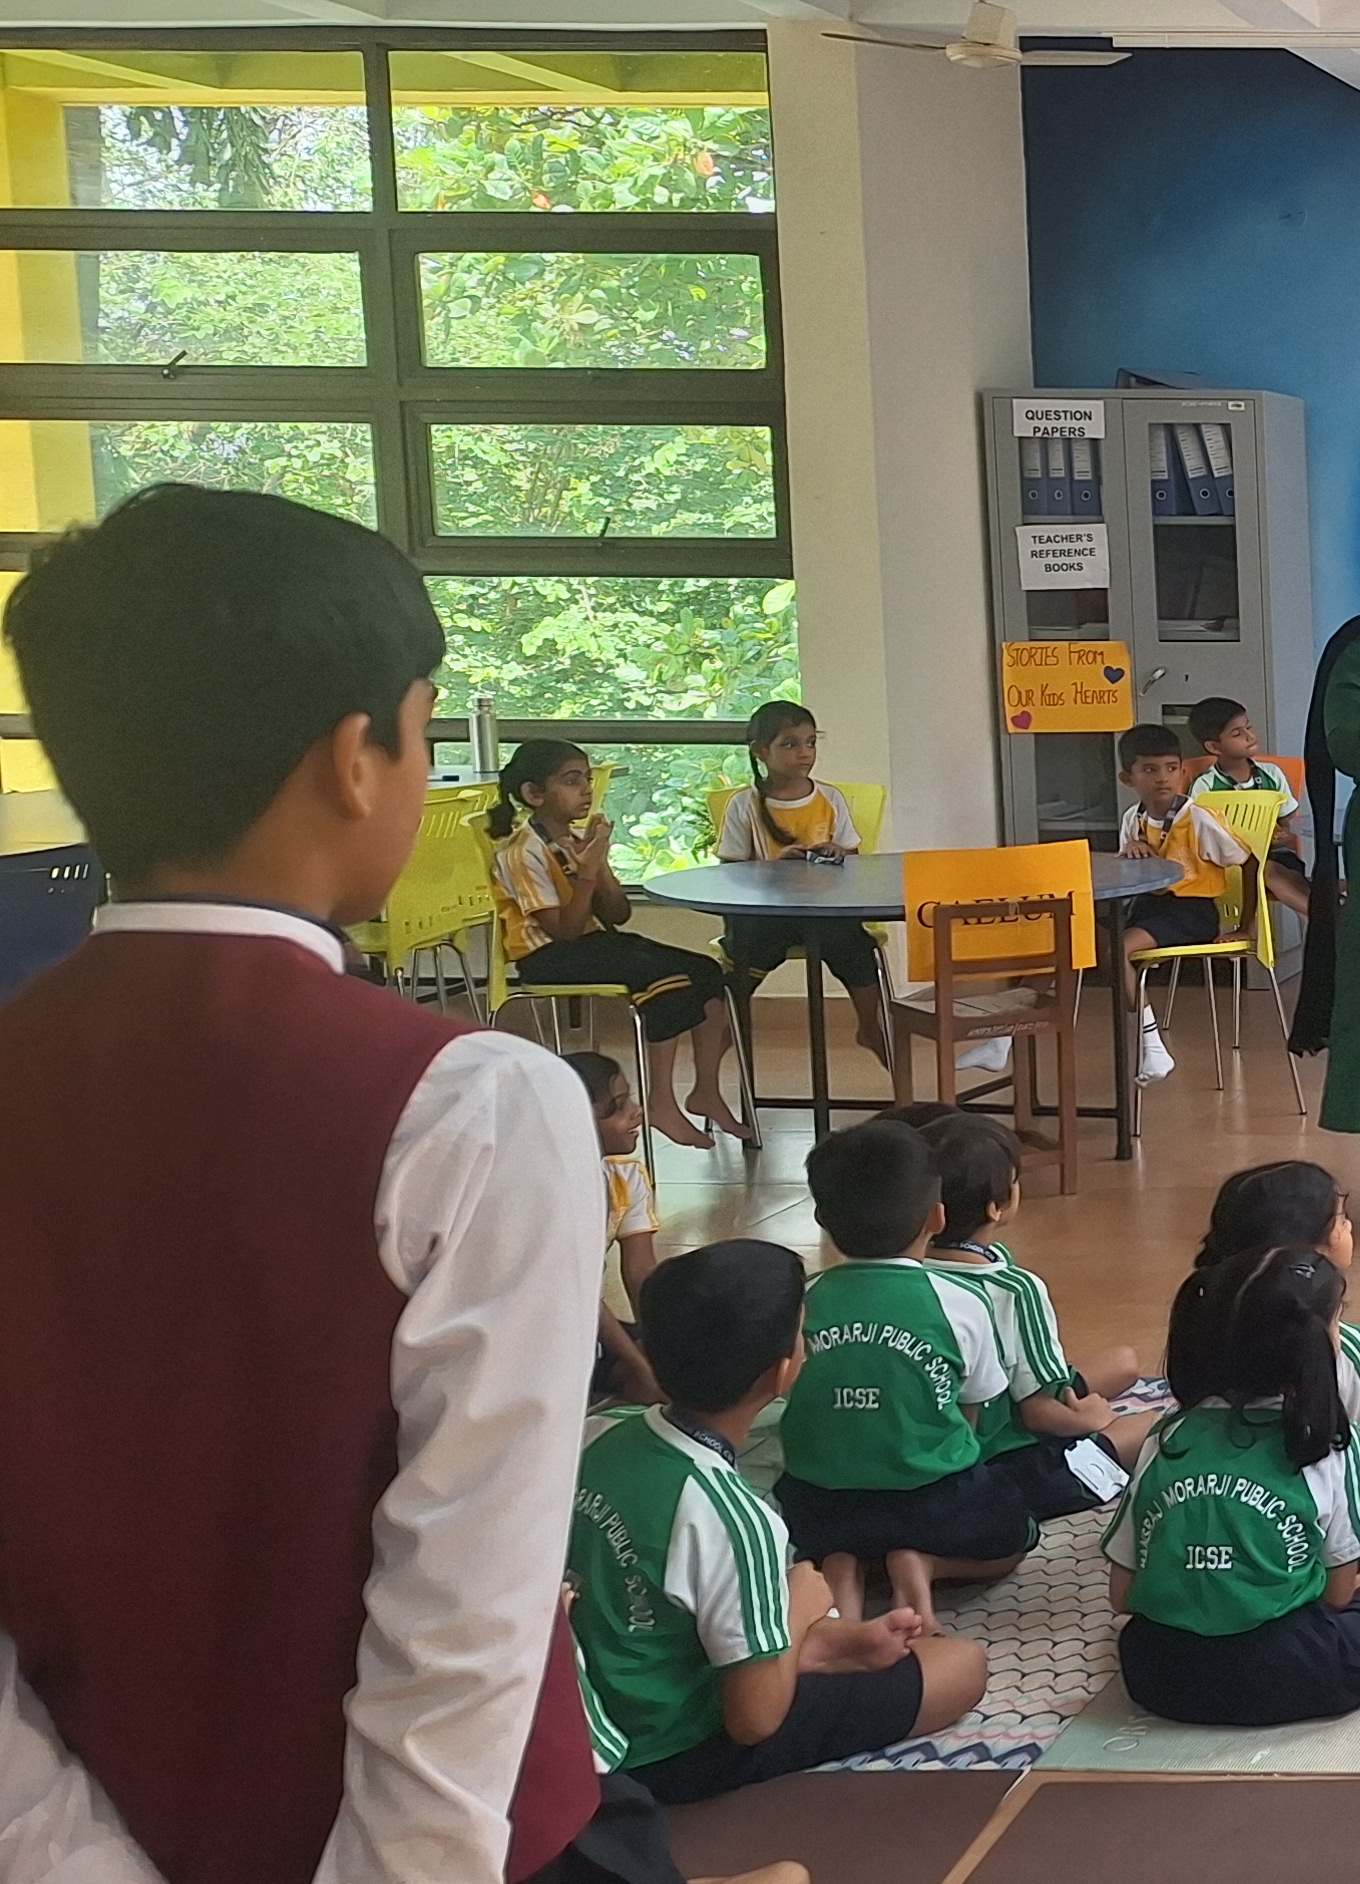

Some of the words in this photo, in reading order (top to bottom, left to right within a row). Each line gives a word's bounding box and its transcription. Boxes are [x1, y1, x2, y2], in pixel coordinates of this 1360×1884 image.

[1025, 409, 1093, 422] QUESTION
[1033, 426, 1086, 438] PAPERS
[1031, 533, 1094, 545] TEACHER'S
[1030, 547, 1097, 559] REFERENCE
[1044, 562, 1084, 573] BOOKS
[1006, 642, 1059, 667] STORIES
[1007, 684, 1035, 707] OUR
[1071, 681, 1118, 705] HEARTS
[808, 1322, 878, 1355] MORARJI
[878, 1323, 932, 1361] PUBLIC
[924, 1355, 953, 1411] SCHOOL
[833, 1387, 881, 1410] ICSE
[1139, 1503, 1165, 1569] HANSRAJ
[1161, 1474, 1232, 1510] MORARJI
[1230, 1477, 1284, 1521] PUBLIC
[1277, 1514, 1310, 1574] SCHOOL
[599, 1512, 638, 1568] PUBLIC
[1185, 1545, 1233, 1570] ICSE
